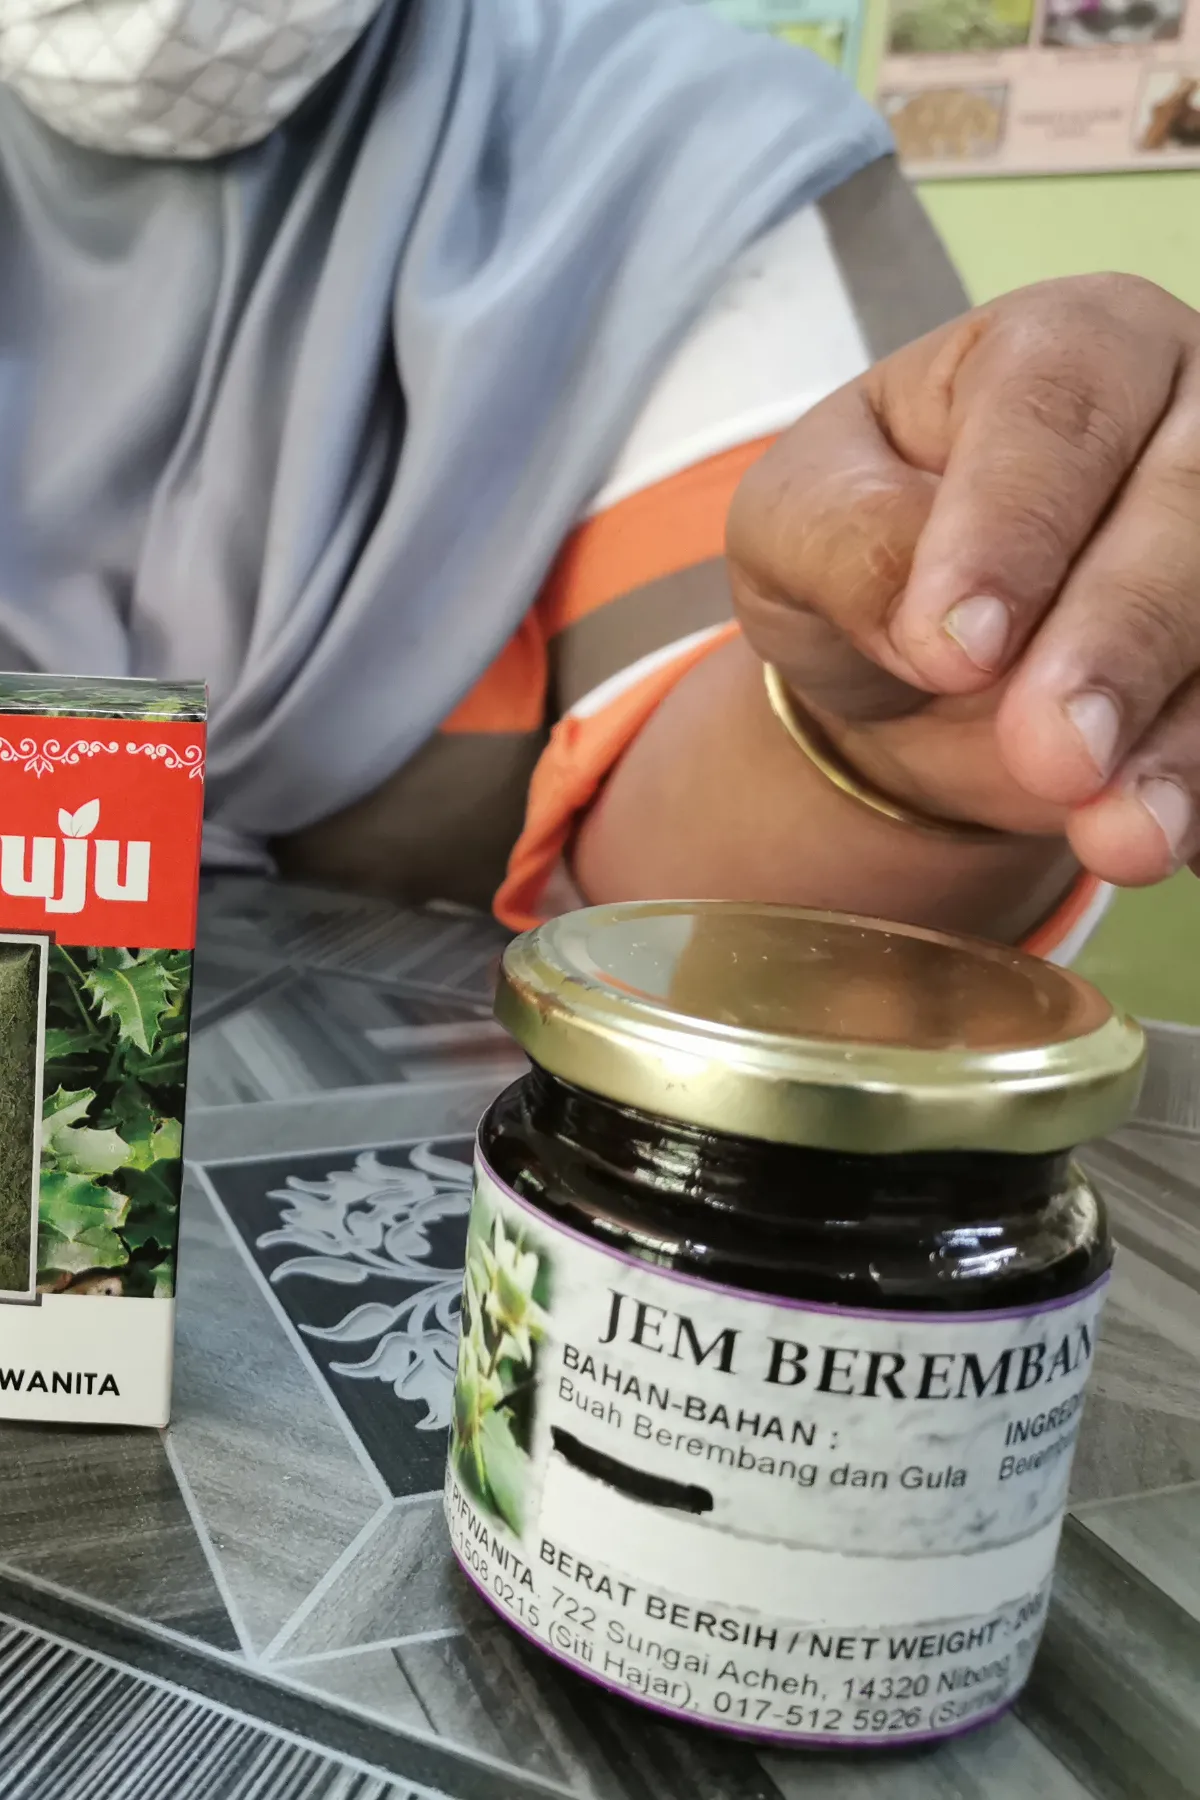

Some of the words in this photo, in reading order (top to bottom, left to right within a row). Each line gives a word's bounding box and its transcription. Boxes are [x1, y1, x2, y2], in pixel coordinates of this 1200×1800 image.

[598, 1287, 742, 1375] JEM
[558, 1376, 624, 1428] Buah
[632, 1413, 818, 1487] Berembang
[828, 1463, 889, 1490] dan
[900, 1464, 969, 1491] Gula
[562, 1343, 817, 1447] BAHAN-BAHAN
[494, 1575, 540, 1628] 0215
[548, 1620, 593, 1663] (Siti
[713, 1691, 843, 1730] 017-512
[853, 1706, 921, 1732] 5926
[539, 1538, 637, 1607] BERAT
[644, 1592, 778, 1651] BERSIH
[808, 1633, 880, 1660] NET
[888, 1618, 1002, 1660] WEIGHT
[551, 1586, 597, 1632] 722
[606, 1619, 710, 1676] Sungai
[843, 1674, 930, 1701] 14320
